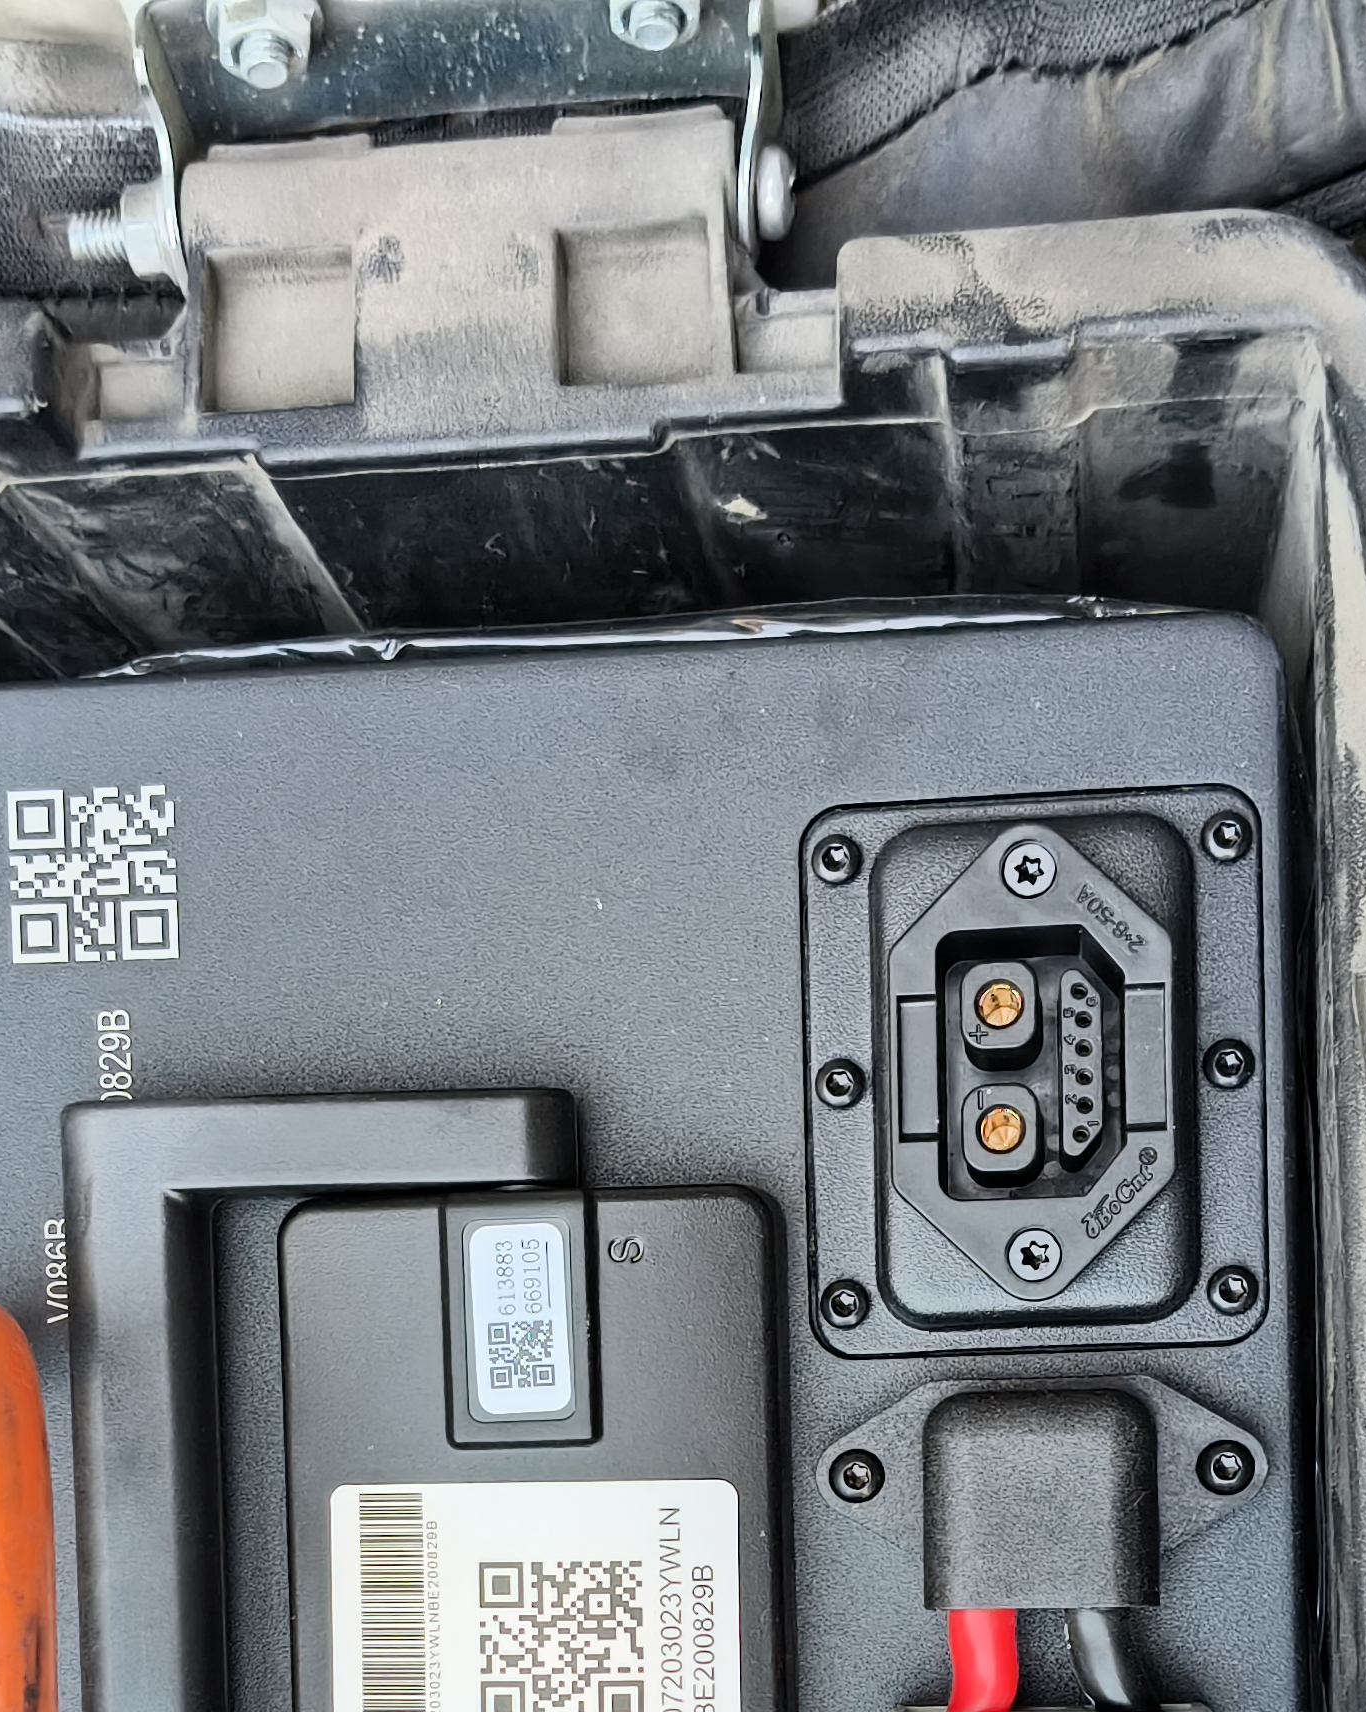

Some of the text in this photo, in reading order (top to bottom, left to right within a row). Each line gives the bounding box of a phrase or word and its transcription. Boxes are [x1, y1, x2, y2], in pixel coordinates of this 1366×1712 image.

[495, 1239, 516, 1316] 613883
[521, 1238, 543, 1314] 669105
[607, 1236, 644, 1264] S
